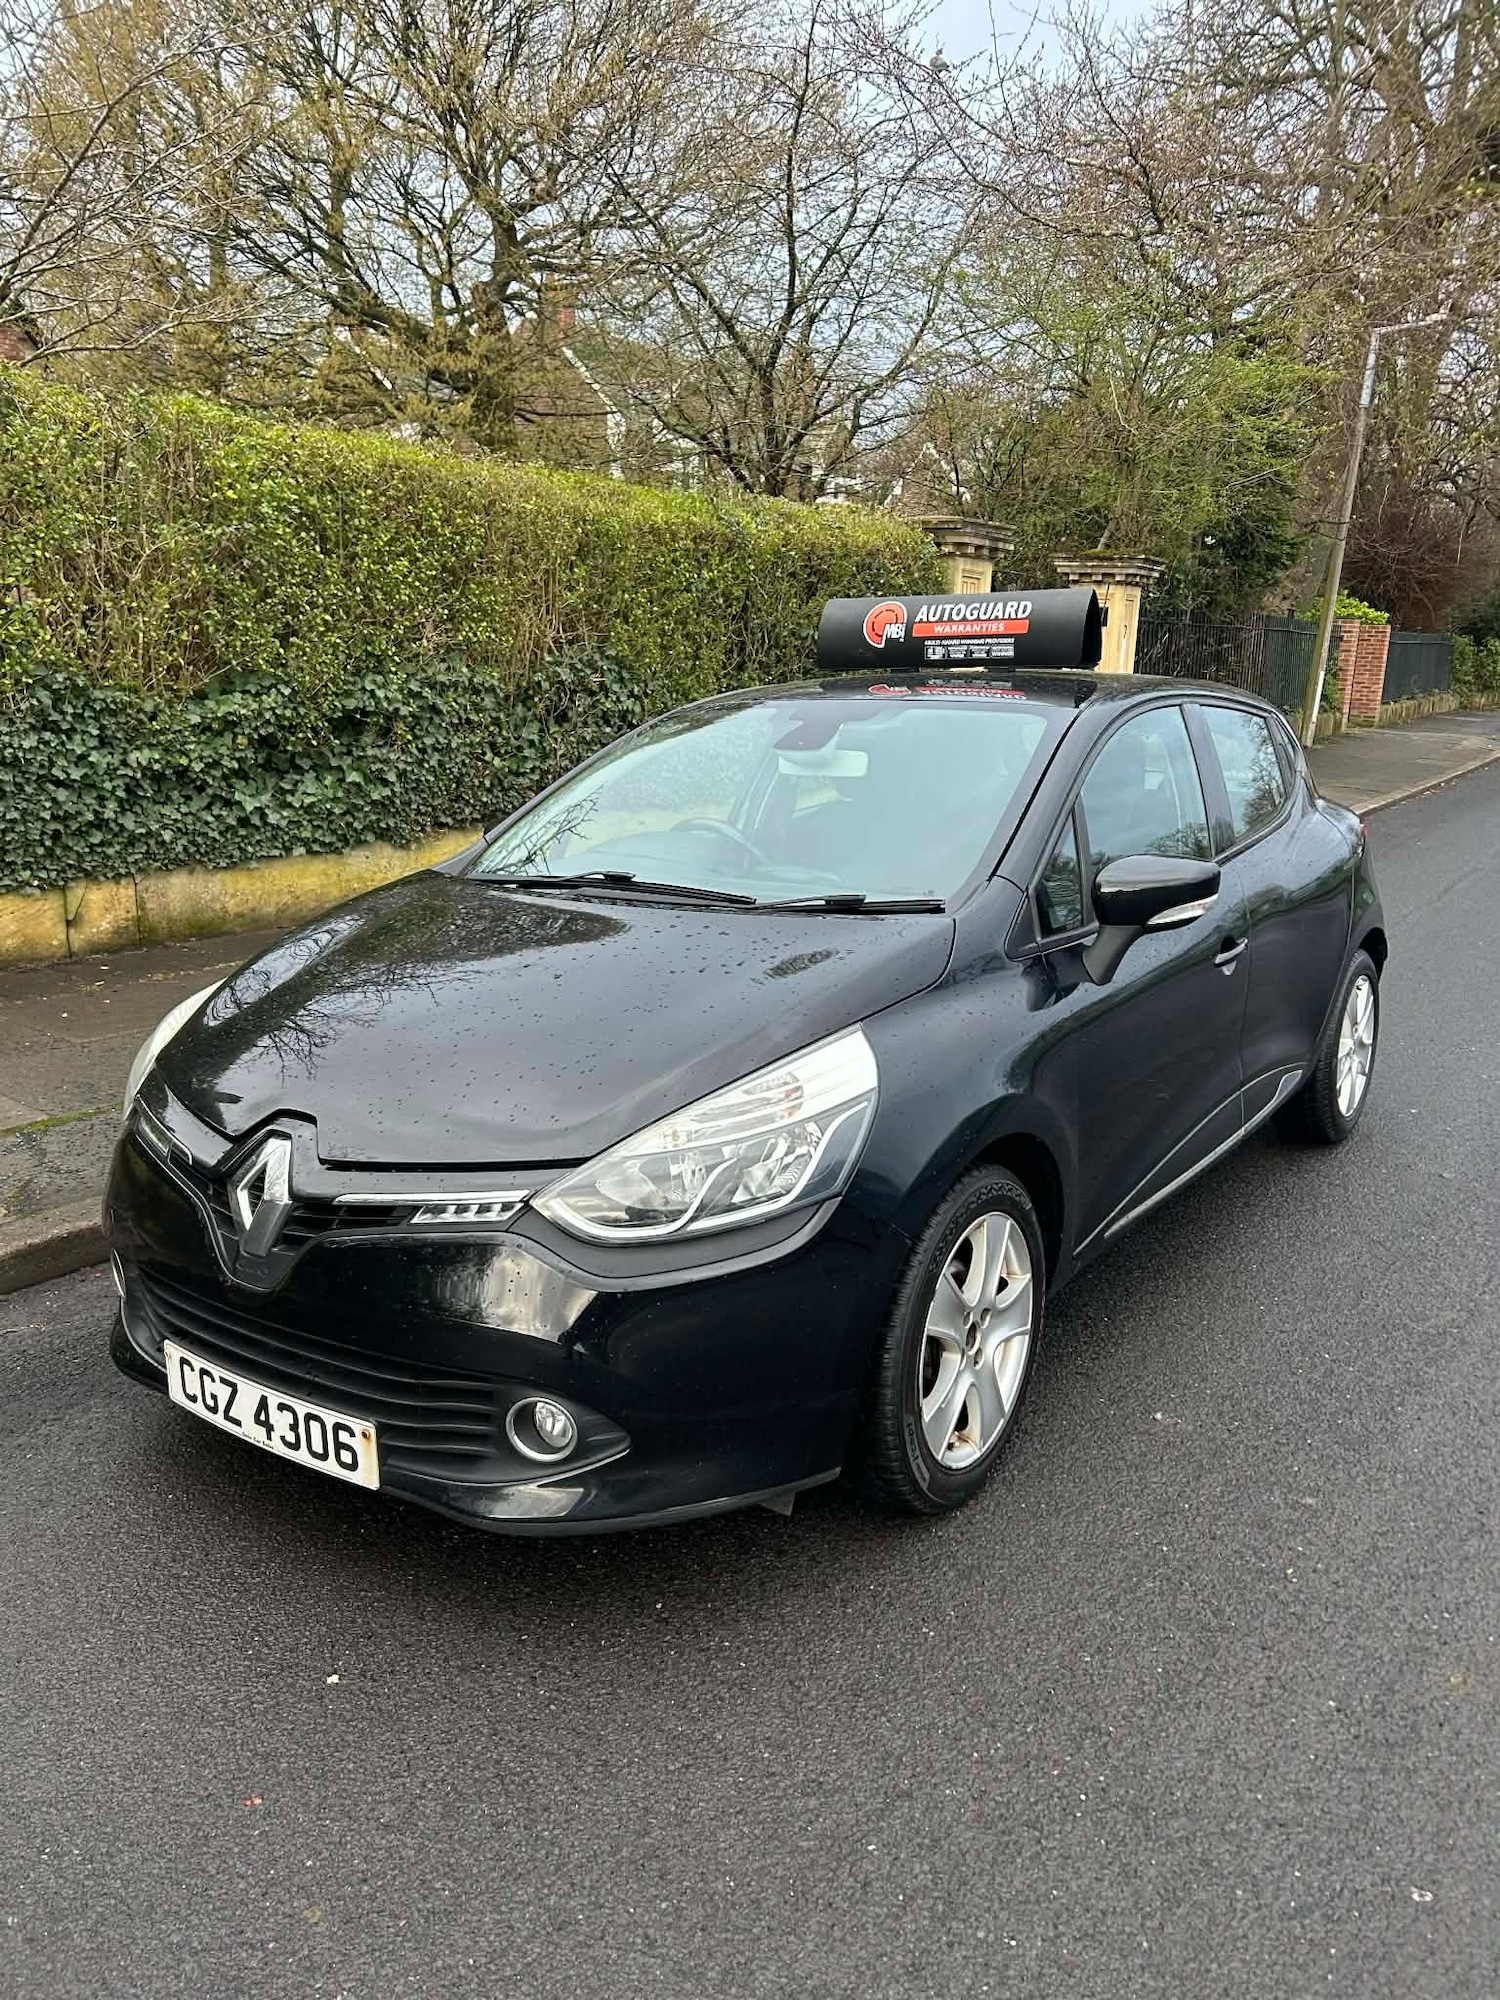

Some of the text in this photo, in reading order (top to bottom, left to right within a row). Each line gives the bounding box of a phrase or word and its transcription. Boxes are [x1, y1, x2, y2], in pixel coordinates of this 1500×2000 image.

[915, 601, 1033, 622] AUTOGUARD
[933, 623, 1005, 634] WARRANTIES
[179, 1356, 359, 1472] CGZ 4306
